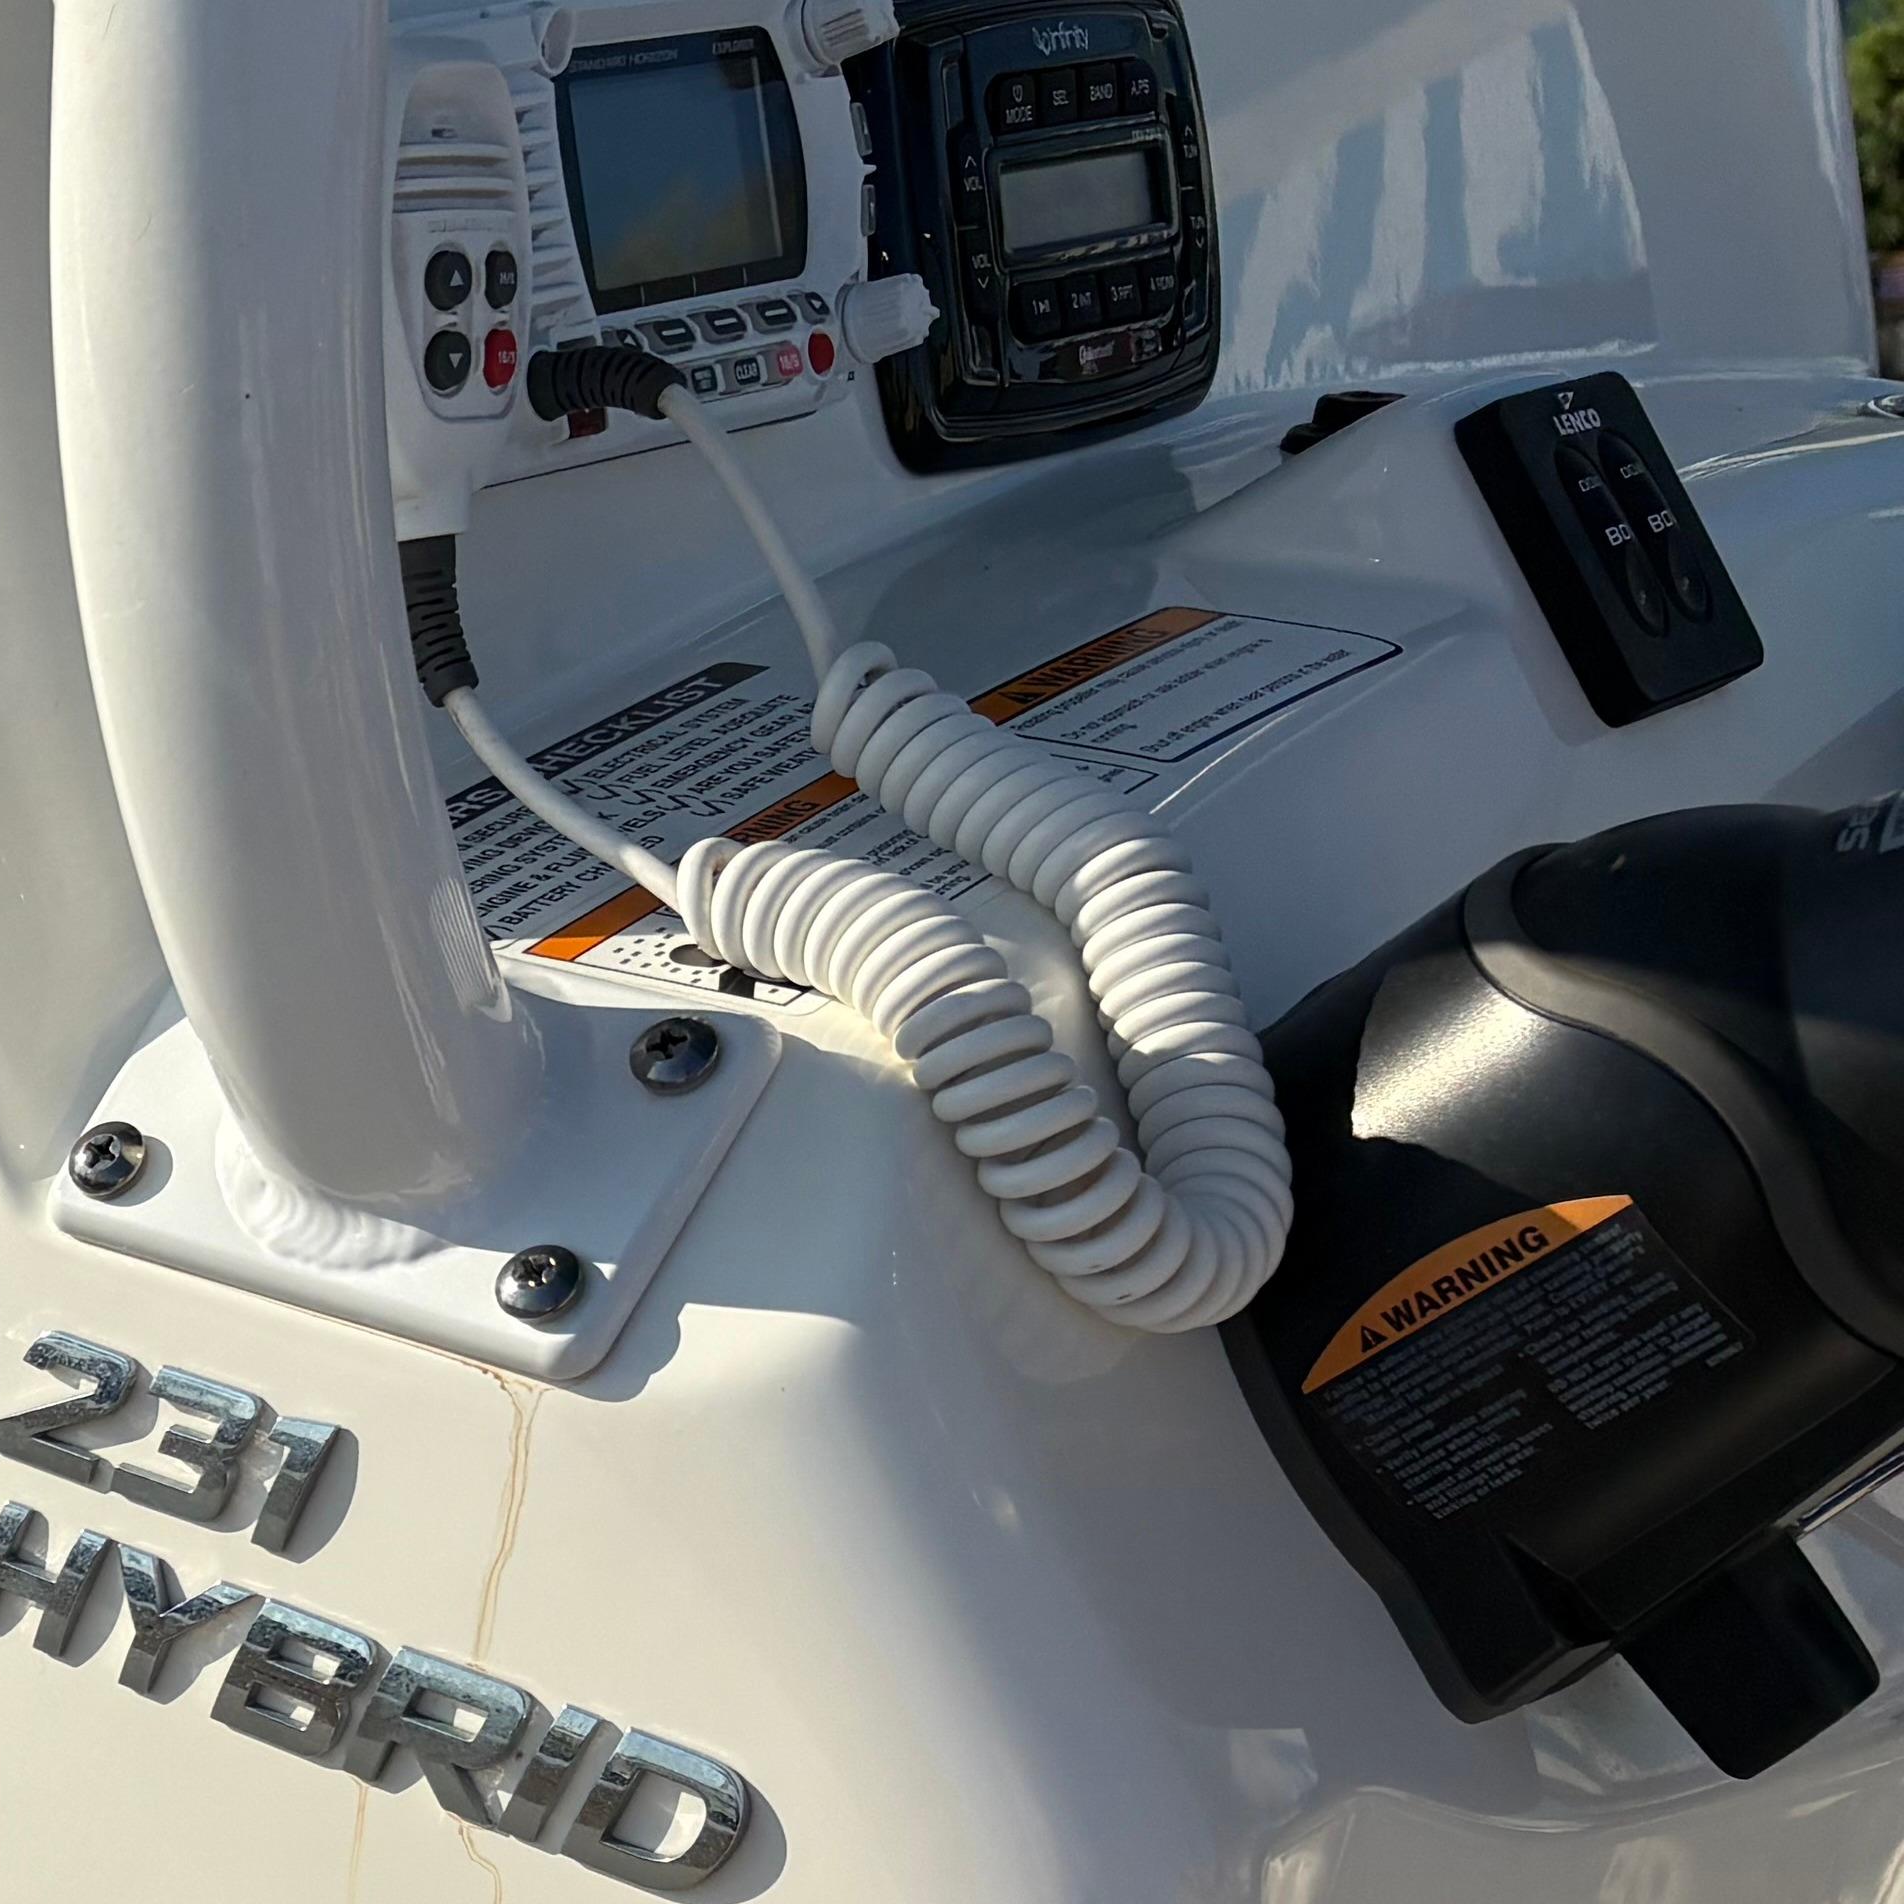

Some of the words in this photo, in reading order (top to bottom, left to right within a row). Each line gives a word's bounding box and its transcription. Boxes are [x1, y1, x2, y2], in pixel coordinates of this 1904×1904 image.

[1553, 408, 1601, 436] LENCO
[1026, 626, 1169, 690] WARNING
[530, 676, 722, 773] HECKLIST
[584, 731, 688, 779] ELECTRICAL
[680, 698, 749, 729] SYSTEM
[617, 764, 670, 784] FUEL
[660, 737, 720, 762] LEVEL
[712, 695, 799, 735] ADEQUATE
[652, 738, 754, 789] EMERGENCY
[750, 715, 803, 738] GEAR
[688, 775, 731, 795] ARE
[719, 758, 763, 775] YOU
[721, 774, 774, 800] SAFE
[728, 800, 820, 844] RNING
[499, 882, 582, 925] BATTERY
[1379, 1225, 1551, 1333] WARNING
